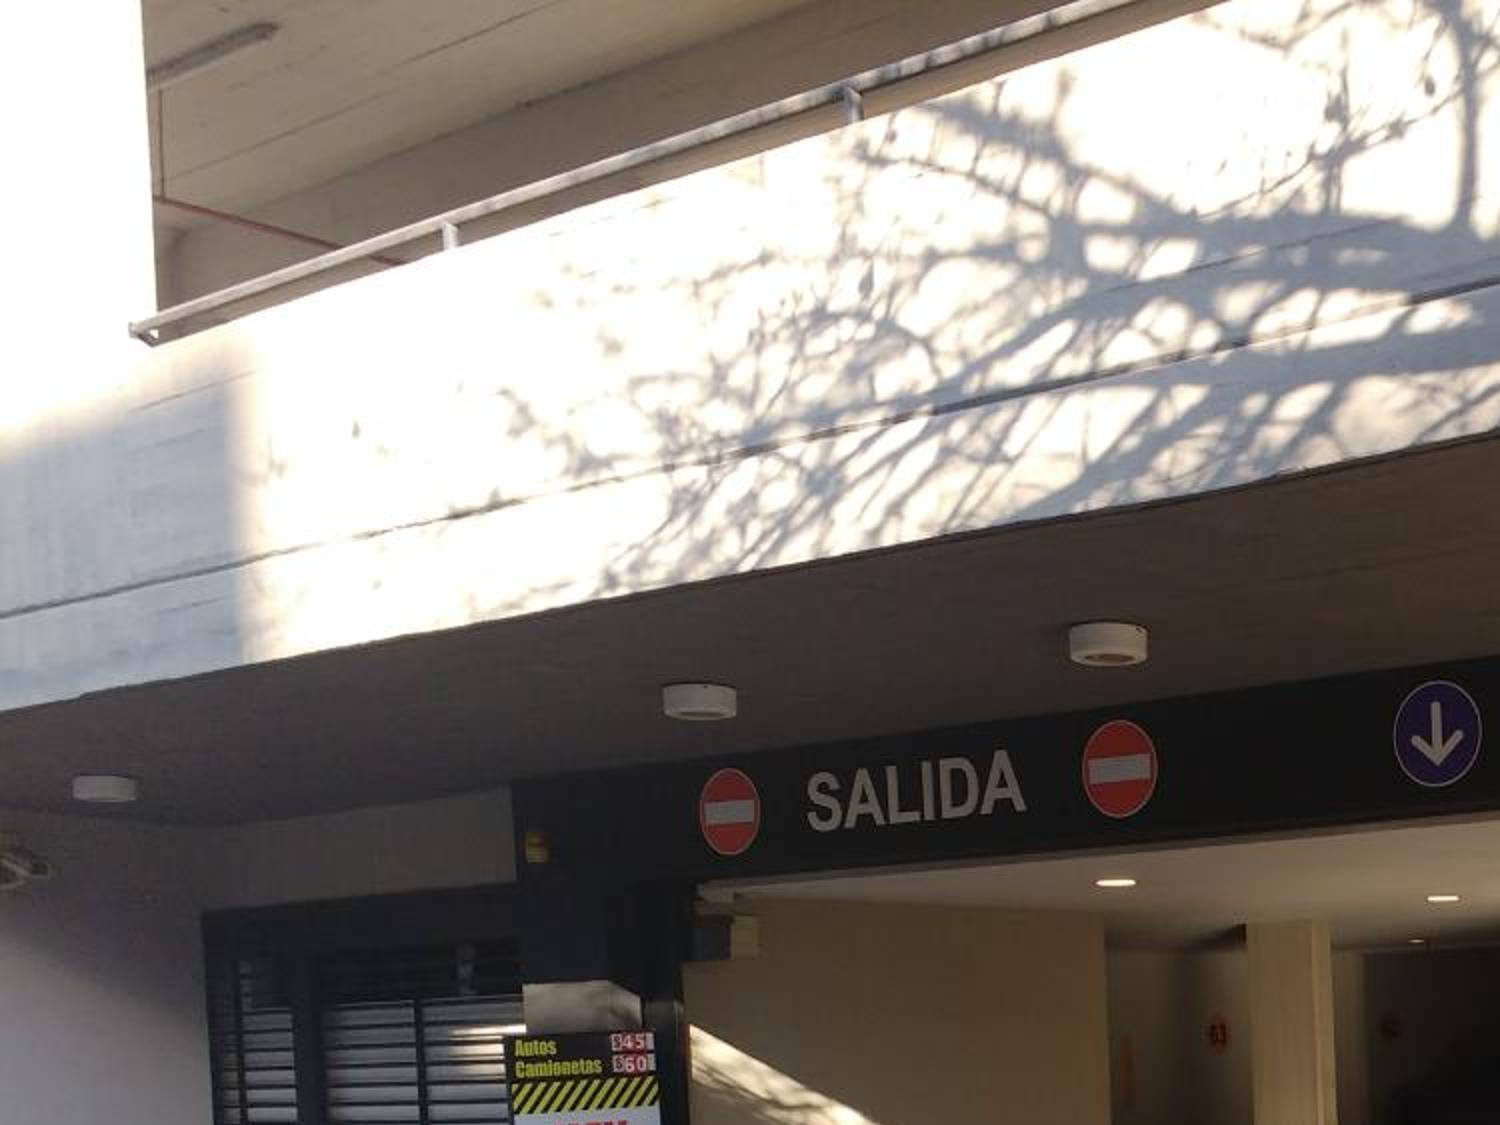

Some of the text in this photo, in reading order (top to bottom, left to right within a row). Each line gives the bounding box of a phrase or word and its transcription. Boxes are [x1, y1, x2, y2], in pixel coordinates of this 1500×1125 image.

[807, 749, 1027, 832] SALIDA
[515, 1039, 557, 1057] Autos
[515, 1058, 602, 1078] Camionetas
